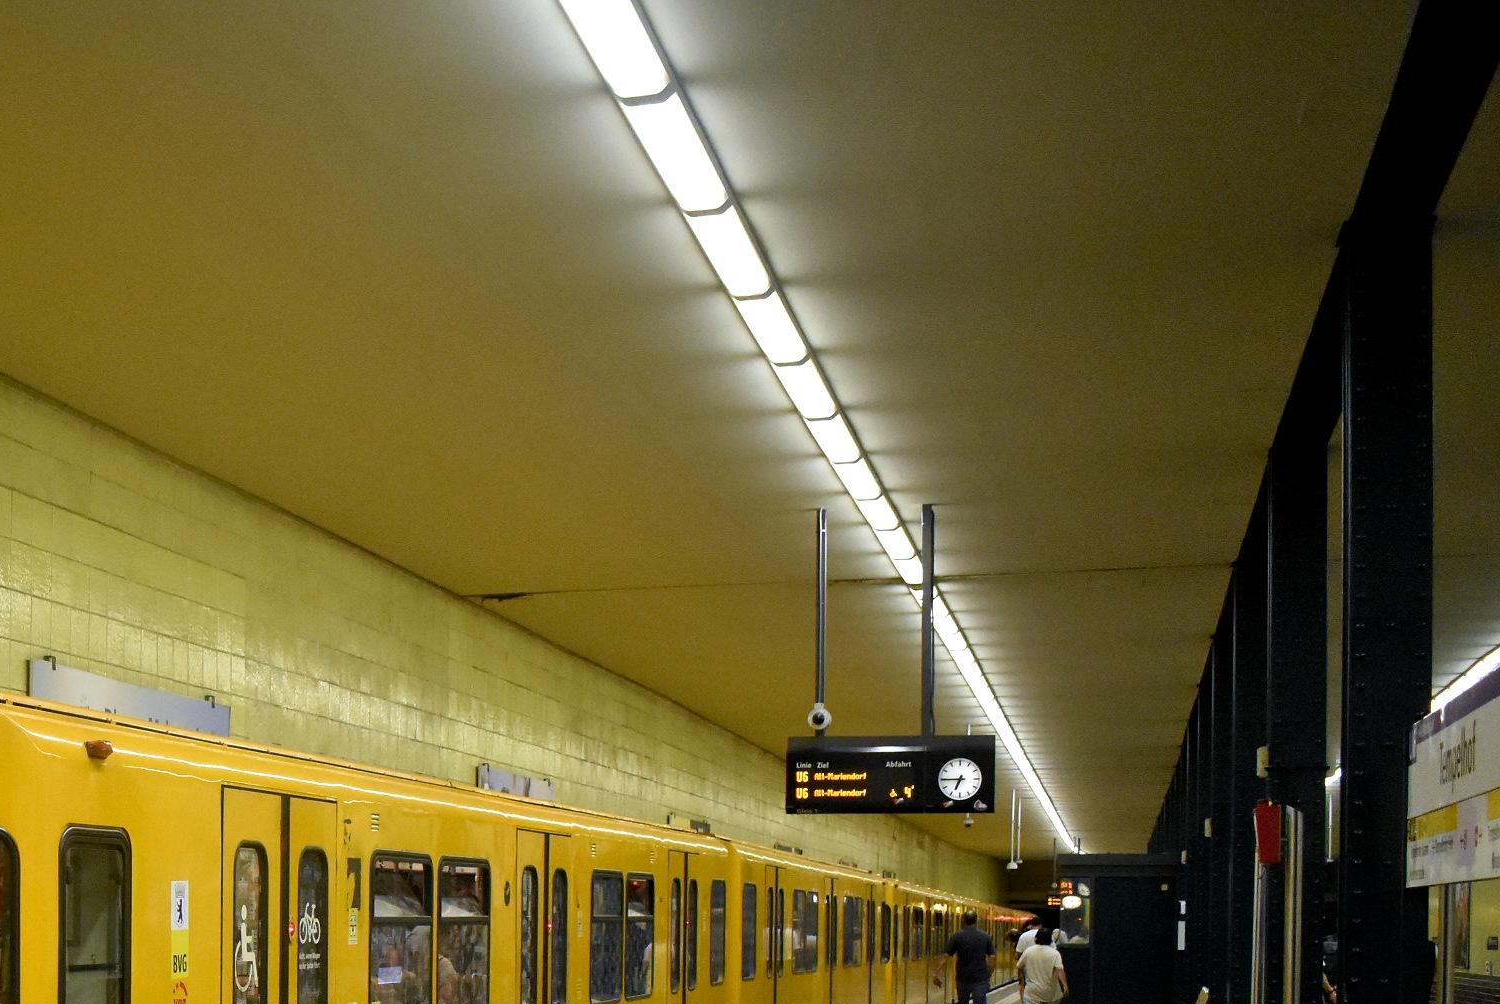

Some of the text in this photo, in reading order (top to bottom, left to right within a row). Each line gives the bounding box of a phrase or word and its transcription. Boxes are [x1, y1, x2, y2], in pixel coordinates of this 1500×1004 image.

[1439, 719, 1477, 795] Tempelhof
[796, 771, 867, 783] U6 Alt-Mariendorf
[796, 788, 809, 799] U6
[813, 789, 867, 797] Alt-Mariendorf
[173, 954, 187, 973] BVG
